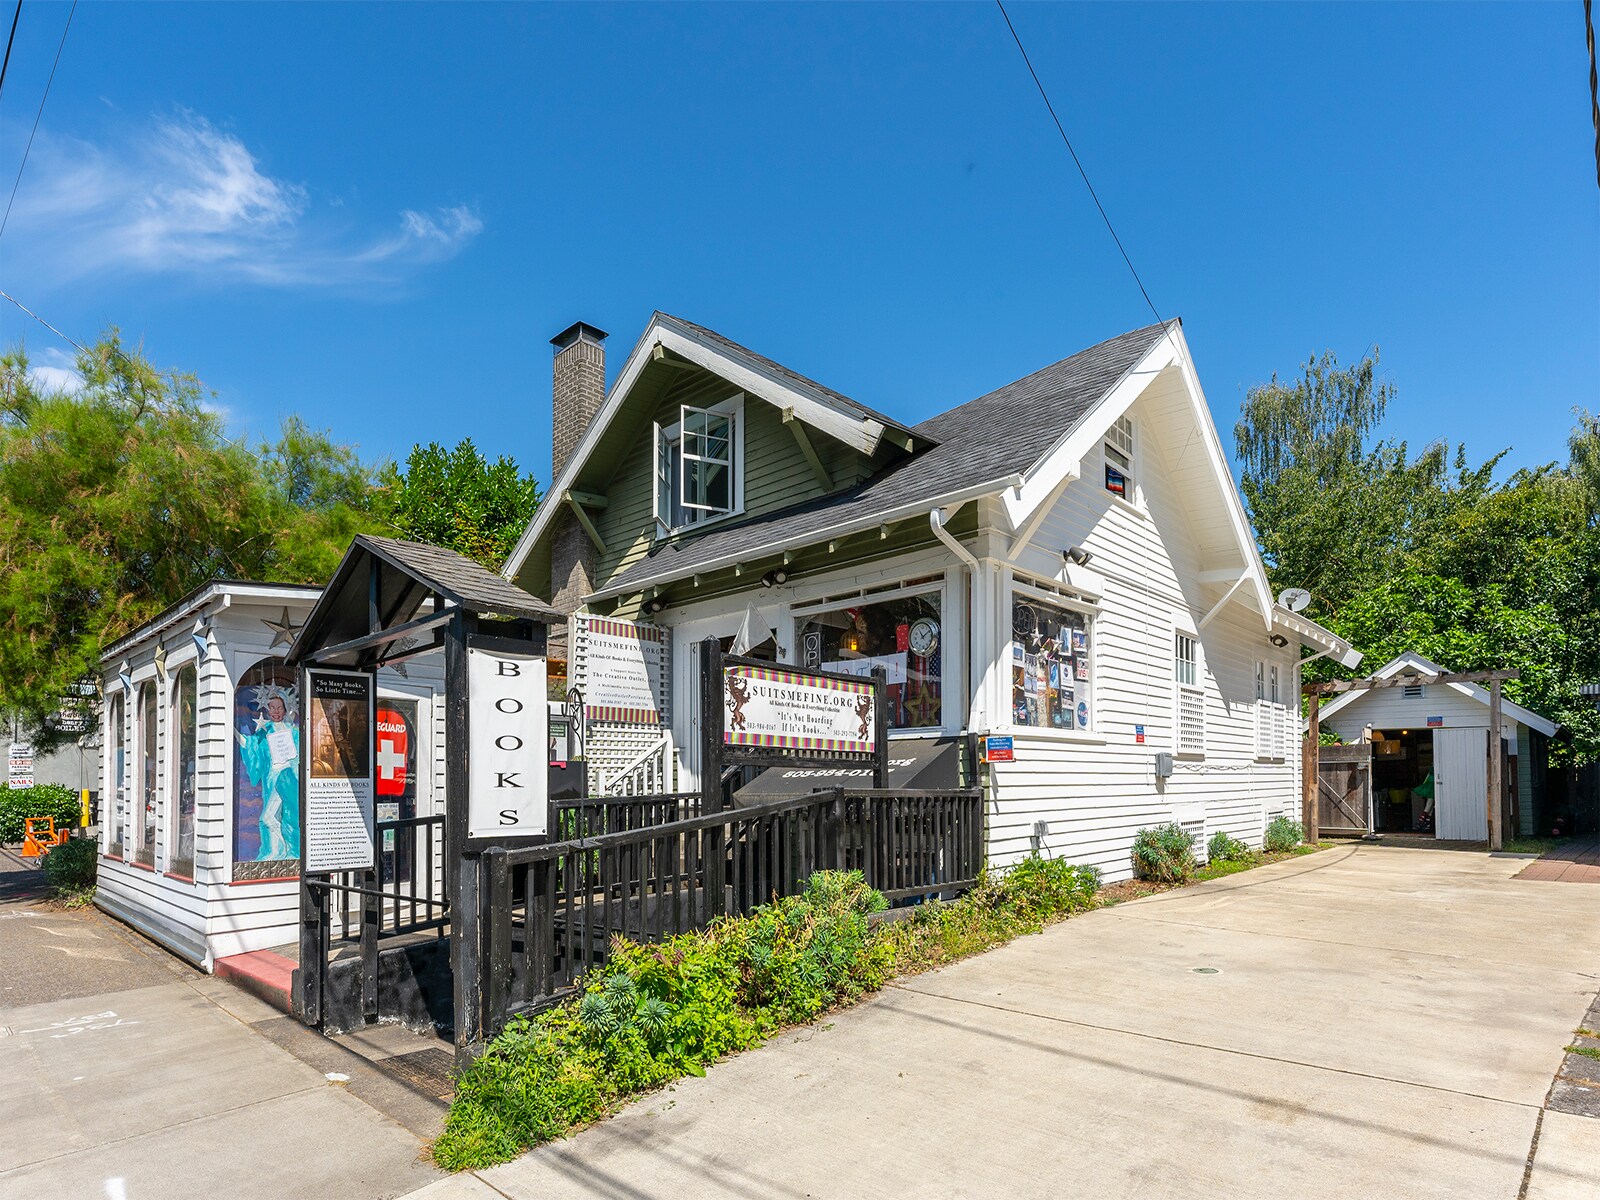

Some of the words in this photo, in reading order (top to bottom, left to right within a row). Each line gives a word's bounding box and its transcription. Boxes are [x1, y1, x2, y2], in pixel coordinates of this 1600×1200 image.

[589, 639, 660, 655] SUITSMEFINE.ORG
[328, 680, 343, 688] Many
[752, 686, 853, 708] SUITSMEFINE.ORG
[794, 713, 804, 722] Not
[807, 714, 833, 726] Hoarding
[377, 722, 406, 733] EGUARD
[782, 722, 788, 732] If
[789, 723, 800, 732] It's
[494, 661, 524, 826] BOOKS
[782, 769, 895, 778] 503-984-01
